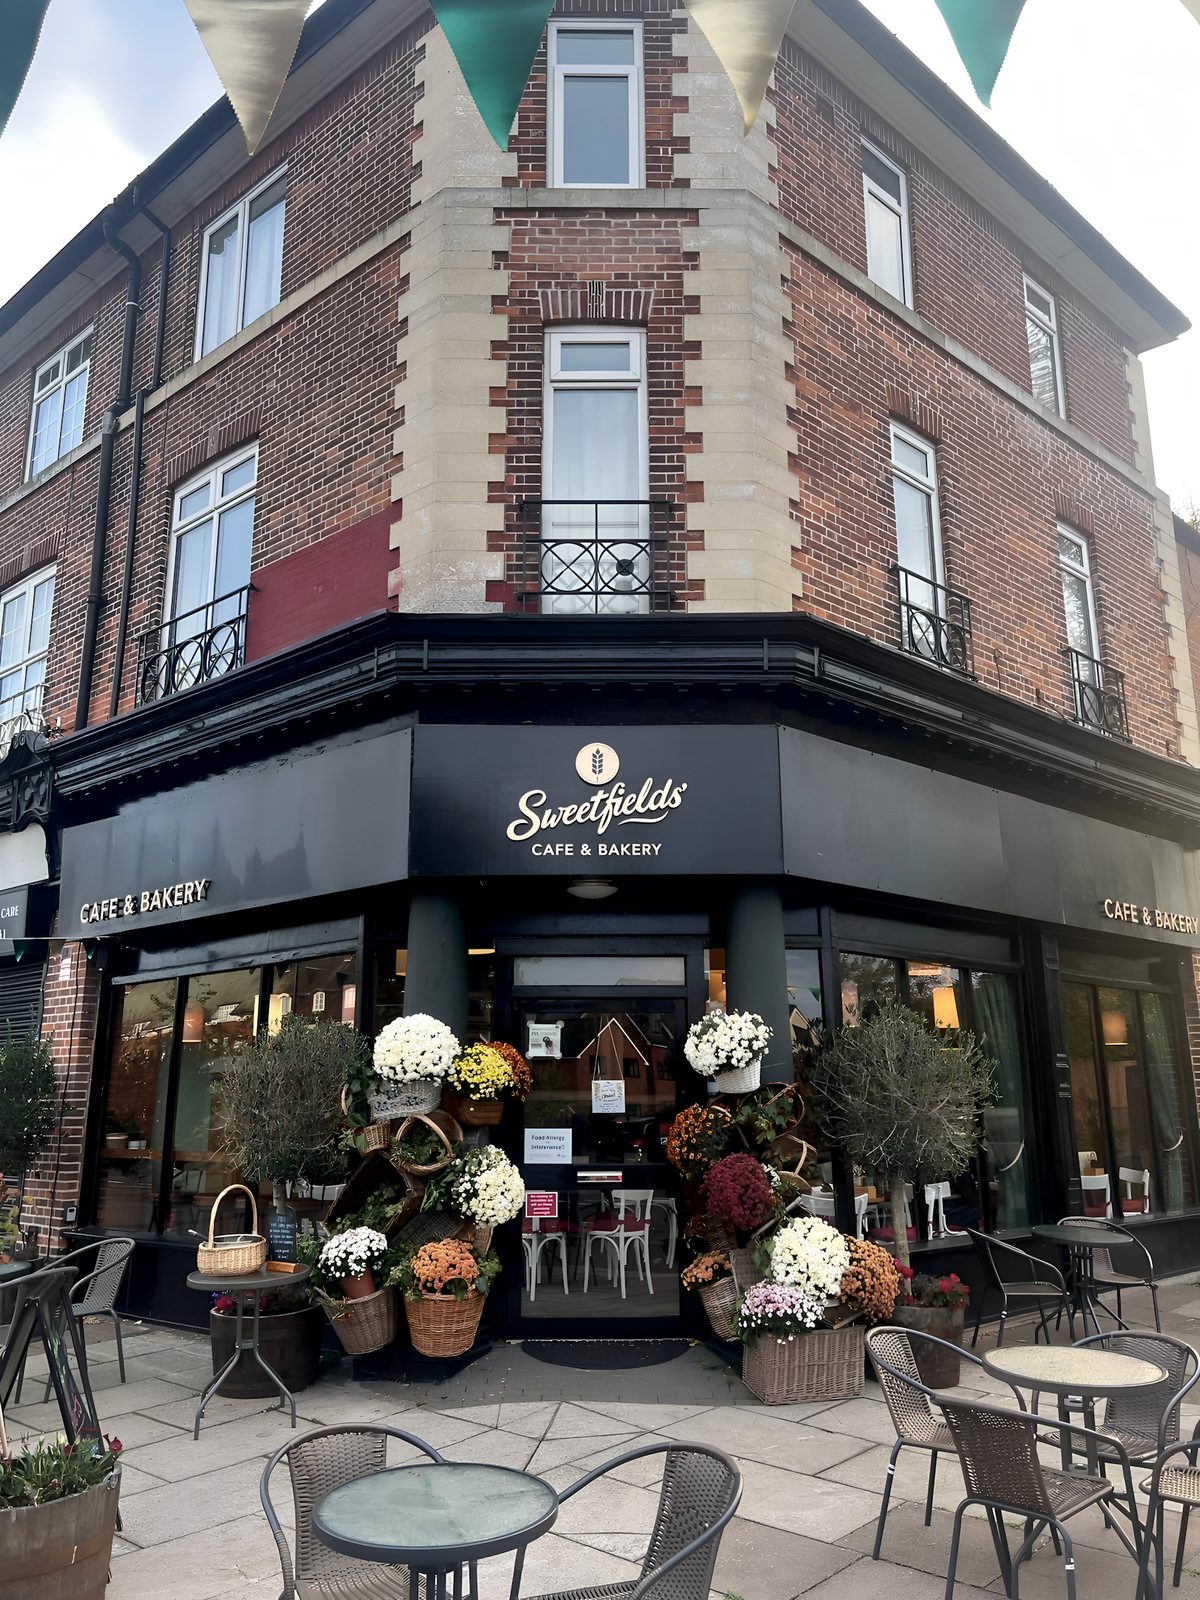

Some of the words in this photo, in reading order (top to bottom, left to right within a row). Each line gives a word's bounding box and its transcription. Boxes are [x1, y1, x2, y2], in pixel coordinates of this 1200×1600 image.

[506, 777, 688, 841] Sweetfields'
[531, 843, 574, 856] CAFE
[580, 843, 592, 856] &
[598, 843, 662, 856] BAKERY
[0, 905, 19, 919] CARE
[80, 897, 120, 924] CAFE
[123, 894, 137, 916] &
[140, 878, 207, 913] BAKERY
[1104, 898, 1139, 924] CAFE
[1142, 906, 1152, 926] &
[1155, 909, 1199, 935] BAKERY
